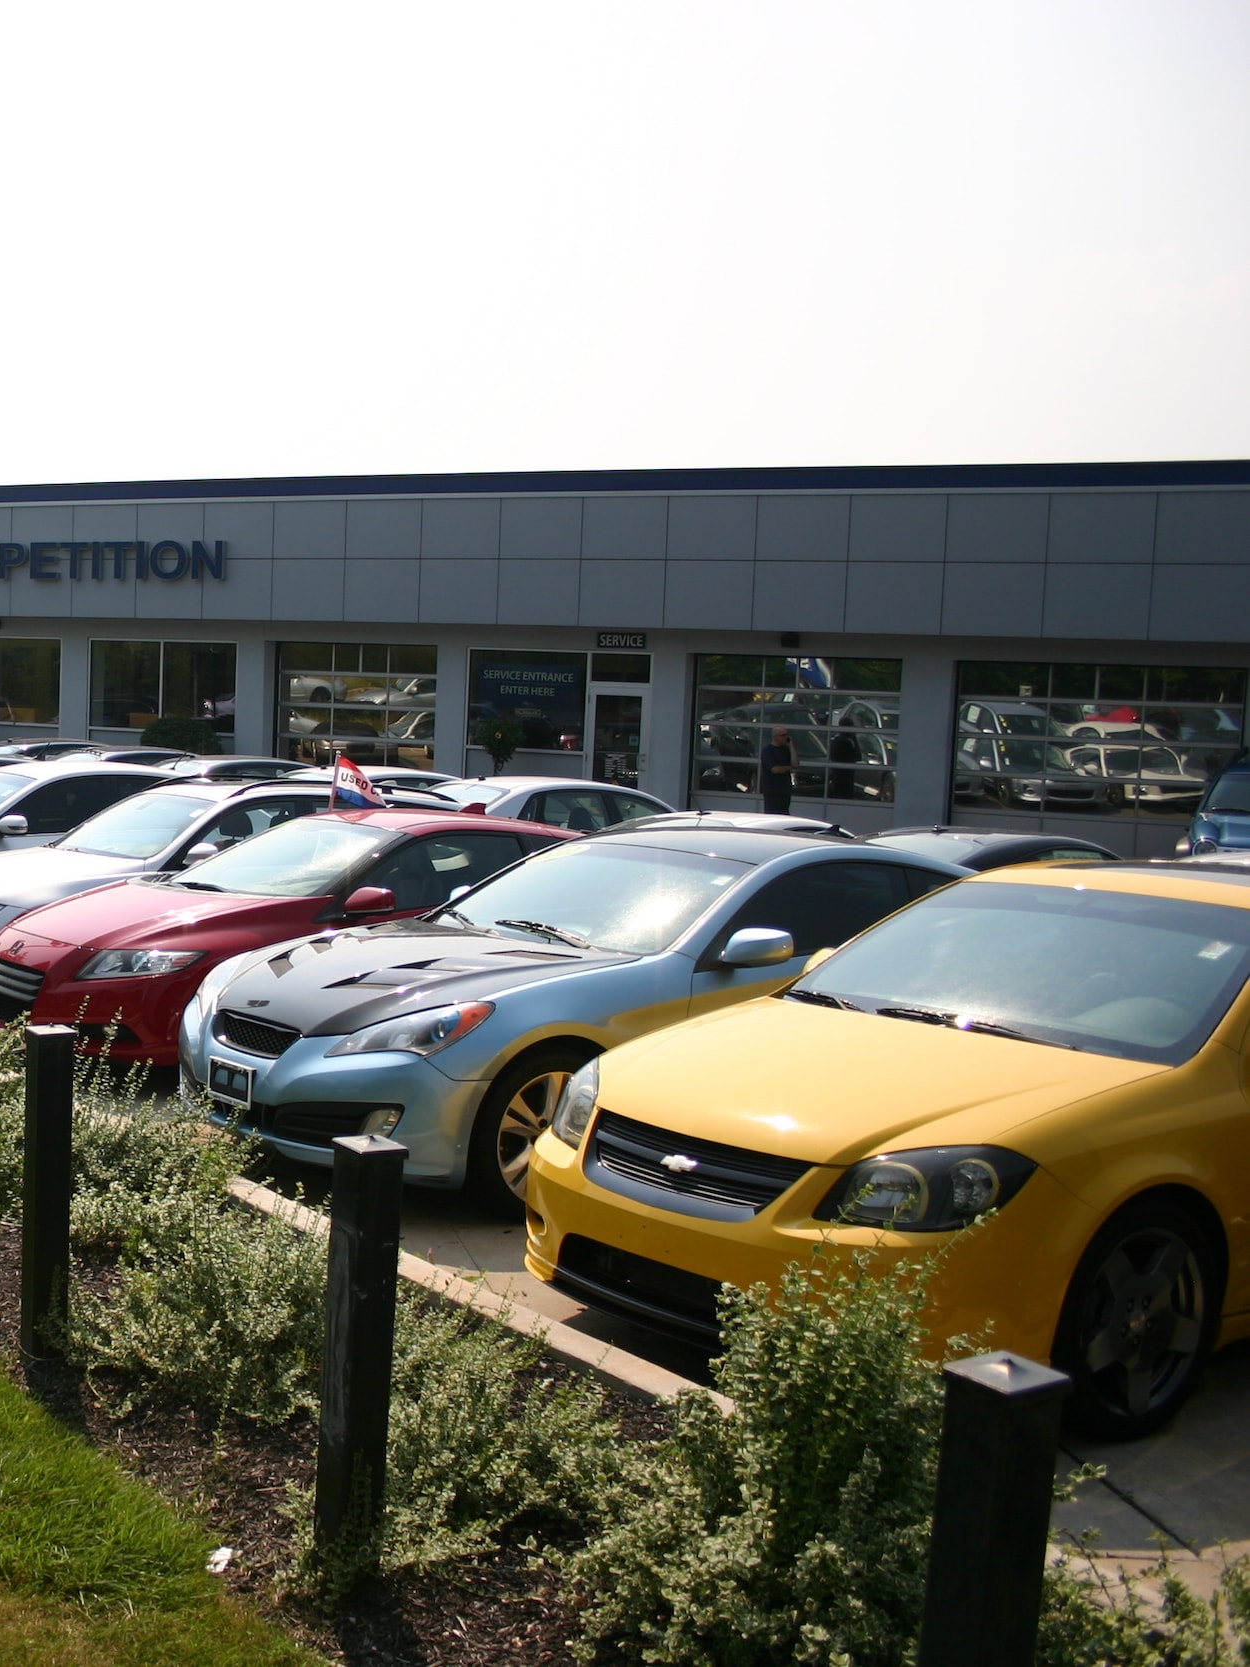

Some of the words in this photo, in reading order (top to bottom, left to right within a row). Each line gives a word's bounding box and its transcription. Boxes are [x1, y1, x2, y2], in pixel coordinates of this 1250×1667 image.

[599, 634, 643, 647] SERVICE
[483, 669, 521, 681] SERVICE
[522, 671, 574, 683] ENTRANCE
[500, 685, 530, 695] ENTER
[530, 687, 556, 697] HERE
[341, 772, 368, 790] USED
